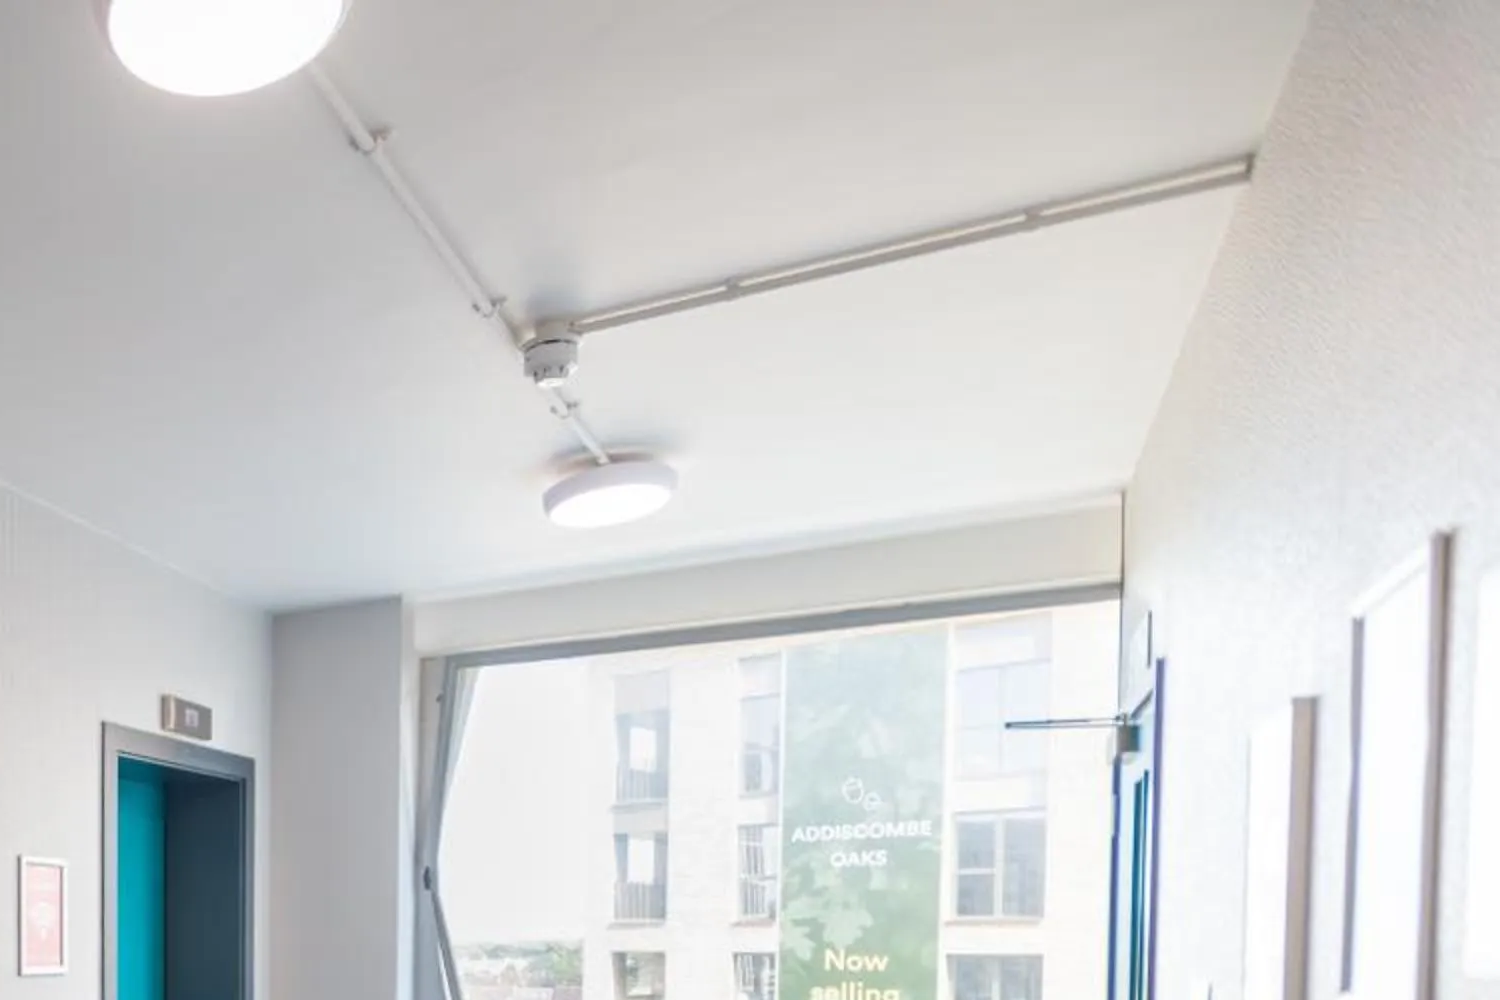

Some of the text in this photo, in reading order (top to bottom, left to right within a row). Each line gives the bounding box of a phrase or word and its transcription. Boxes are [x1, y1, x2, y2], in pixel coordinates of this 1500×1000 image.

[790, 820, 933, 843] ADDISCOMBE
[830, 849, 888, 867] OAKS
[824, 948, 889, 972] Now
